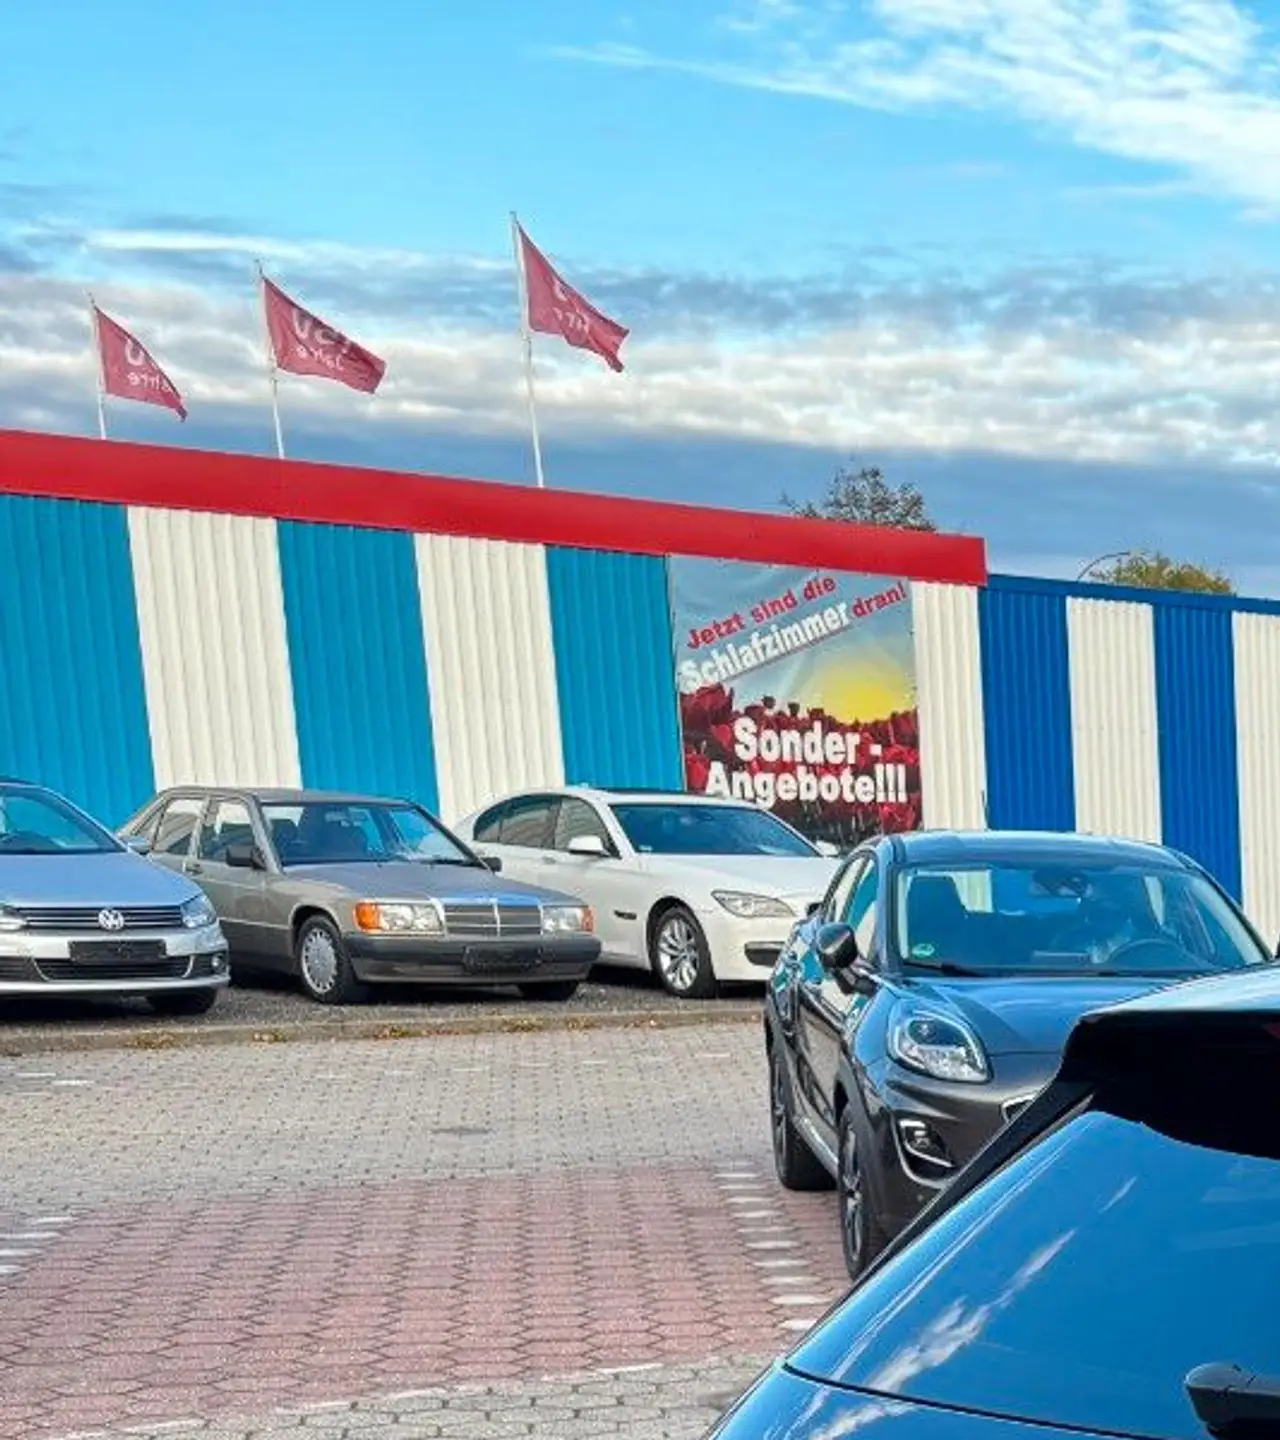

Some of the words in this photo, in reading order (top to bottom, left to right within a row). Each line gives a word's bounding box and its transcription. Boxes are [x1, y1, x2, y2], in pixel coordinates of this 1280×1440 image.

[679, 602, 850, 694] Schlafzimmer
[851, 582, 907, 618] dran!
[687, 613, 746, 649] Jetzt
[750, 589, 799, 624] sind
[802, 576, 837, 601] die
[705, 760, 908, 811] Angebote!!!
